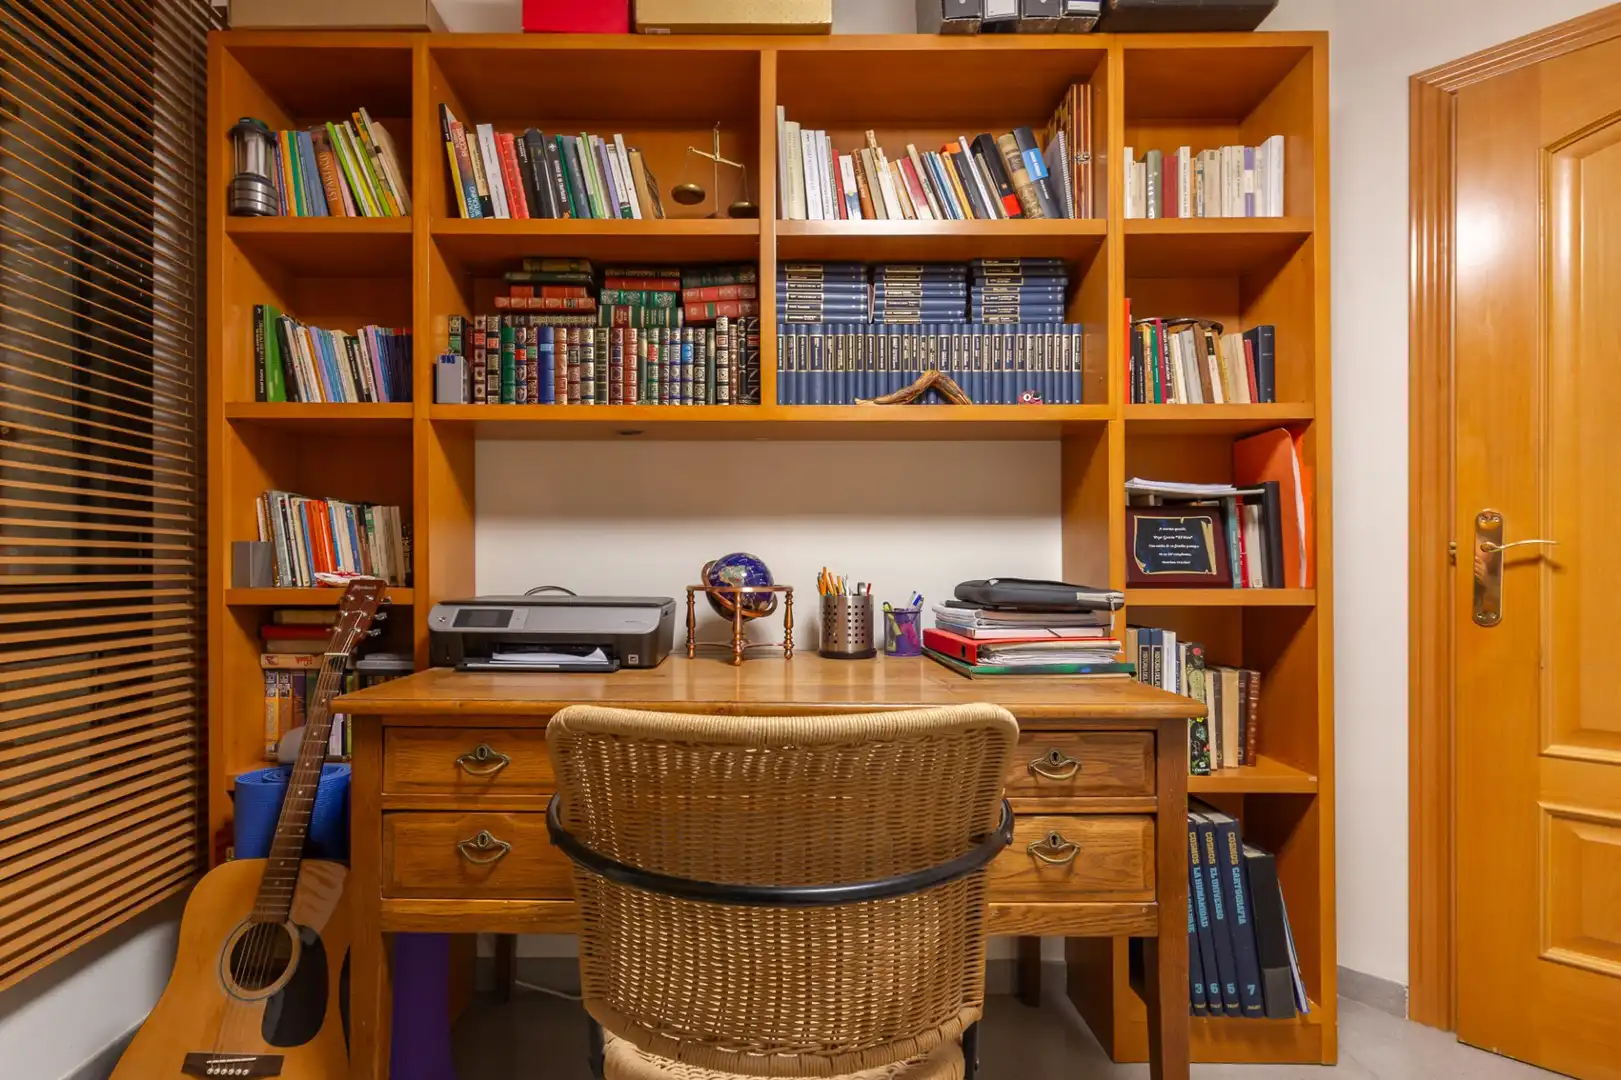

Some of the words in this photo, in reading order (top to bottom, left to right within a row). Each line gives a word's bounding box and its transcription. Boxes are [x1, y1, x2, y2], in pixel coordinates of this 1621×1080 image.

[1189, 832, 1200, 865] COSMOS
[1228, 832, 1239, 865] COSMOS
[1205, 832, 1216, 865] COSMOS
[1212, 879, 1224, 920] UNIVERSO
[1194, 983, 1203, 994] 3
[1210, 983, 1219, 994] 6
[1227, 983, 1235, 994] 5
[1247, 984, 1256, 996] 7
